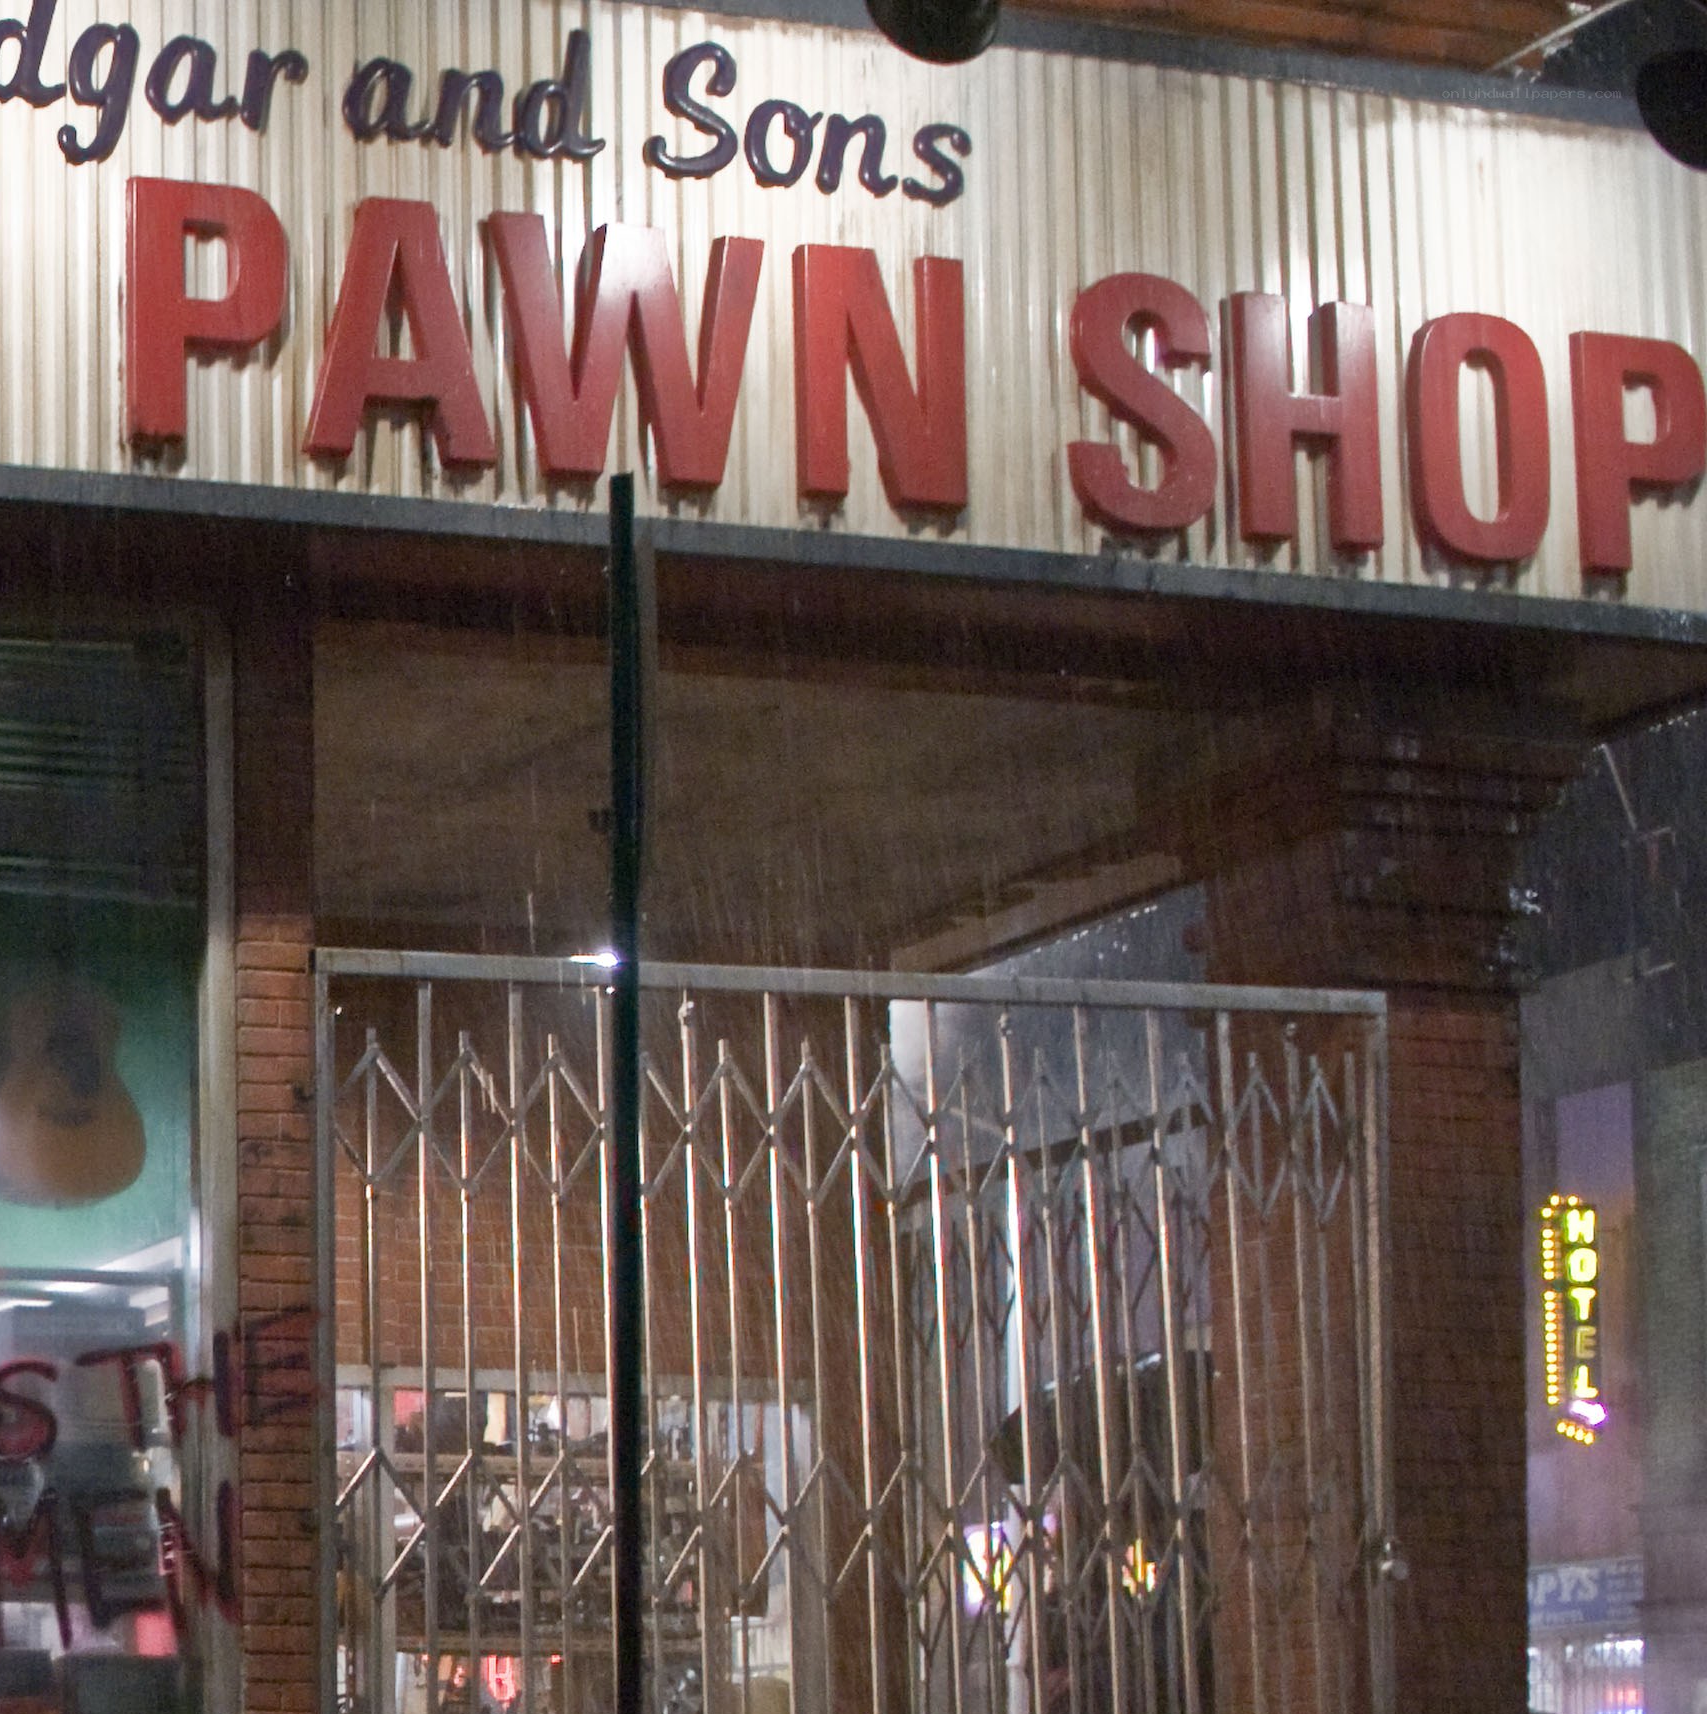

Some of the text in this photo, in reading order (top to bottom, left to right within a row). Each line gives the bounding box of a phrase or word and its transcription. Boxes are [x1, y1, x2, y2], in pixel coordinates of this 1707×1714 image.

[342, 28, 605, 160] and
[643, 40, 973, 205] Sons
[124, 174, 1707, 574] PAWN SHOP
[75, 1303, 323, 1453] THE
[1563, 1208, 1600, 1400] HOTEL
